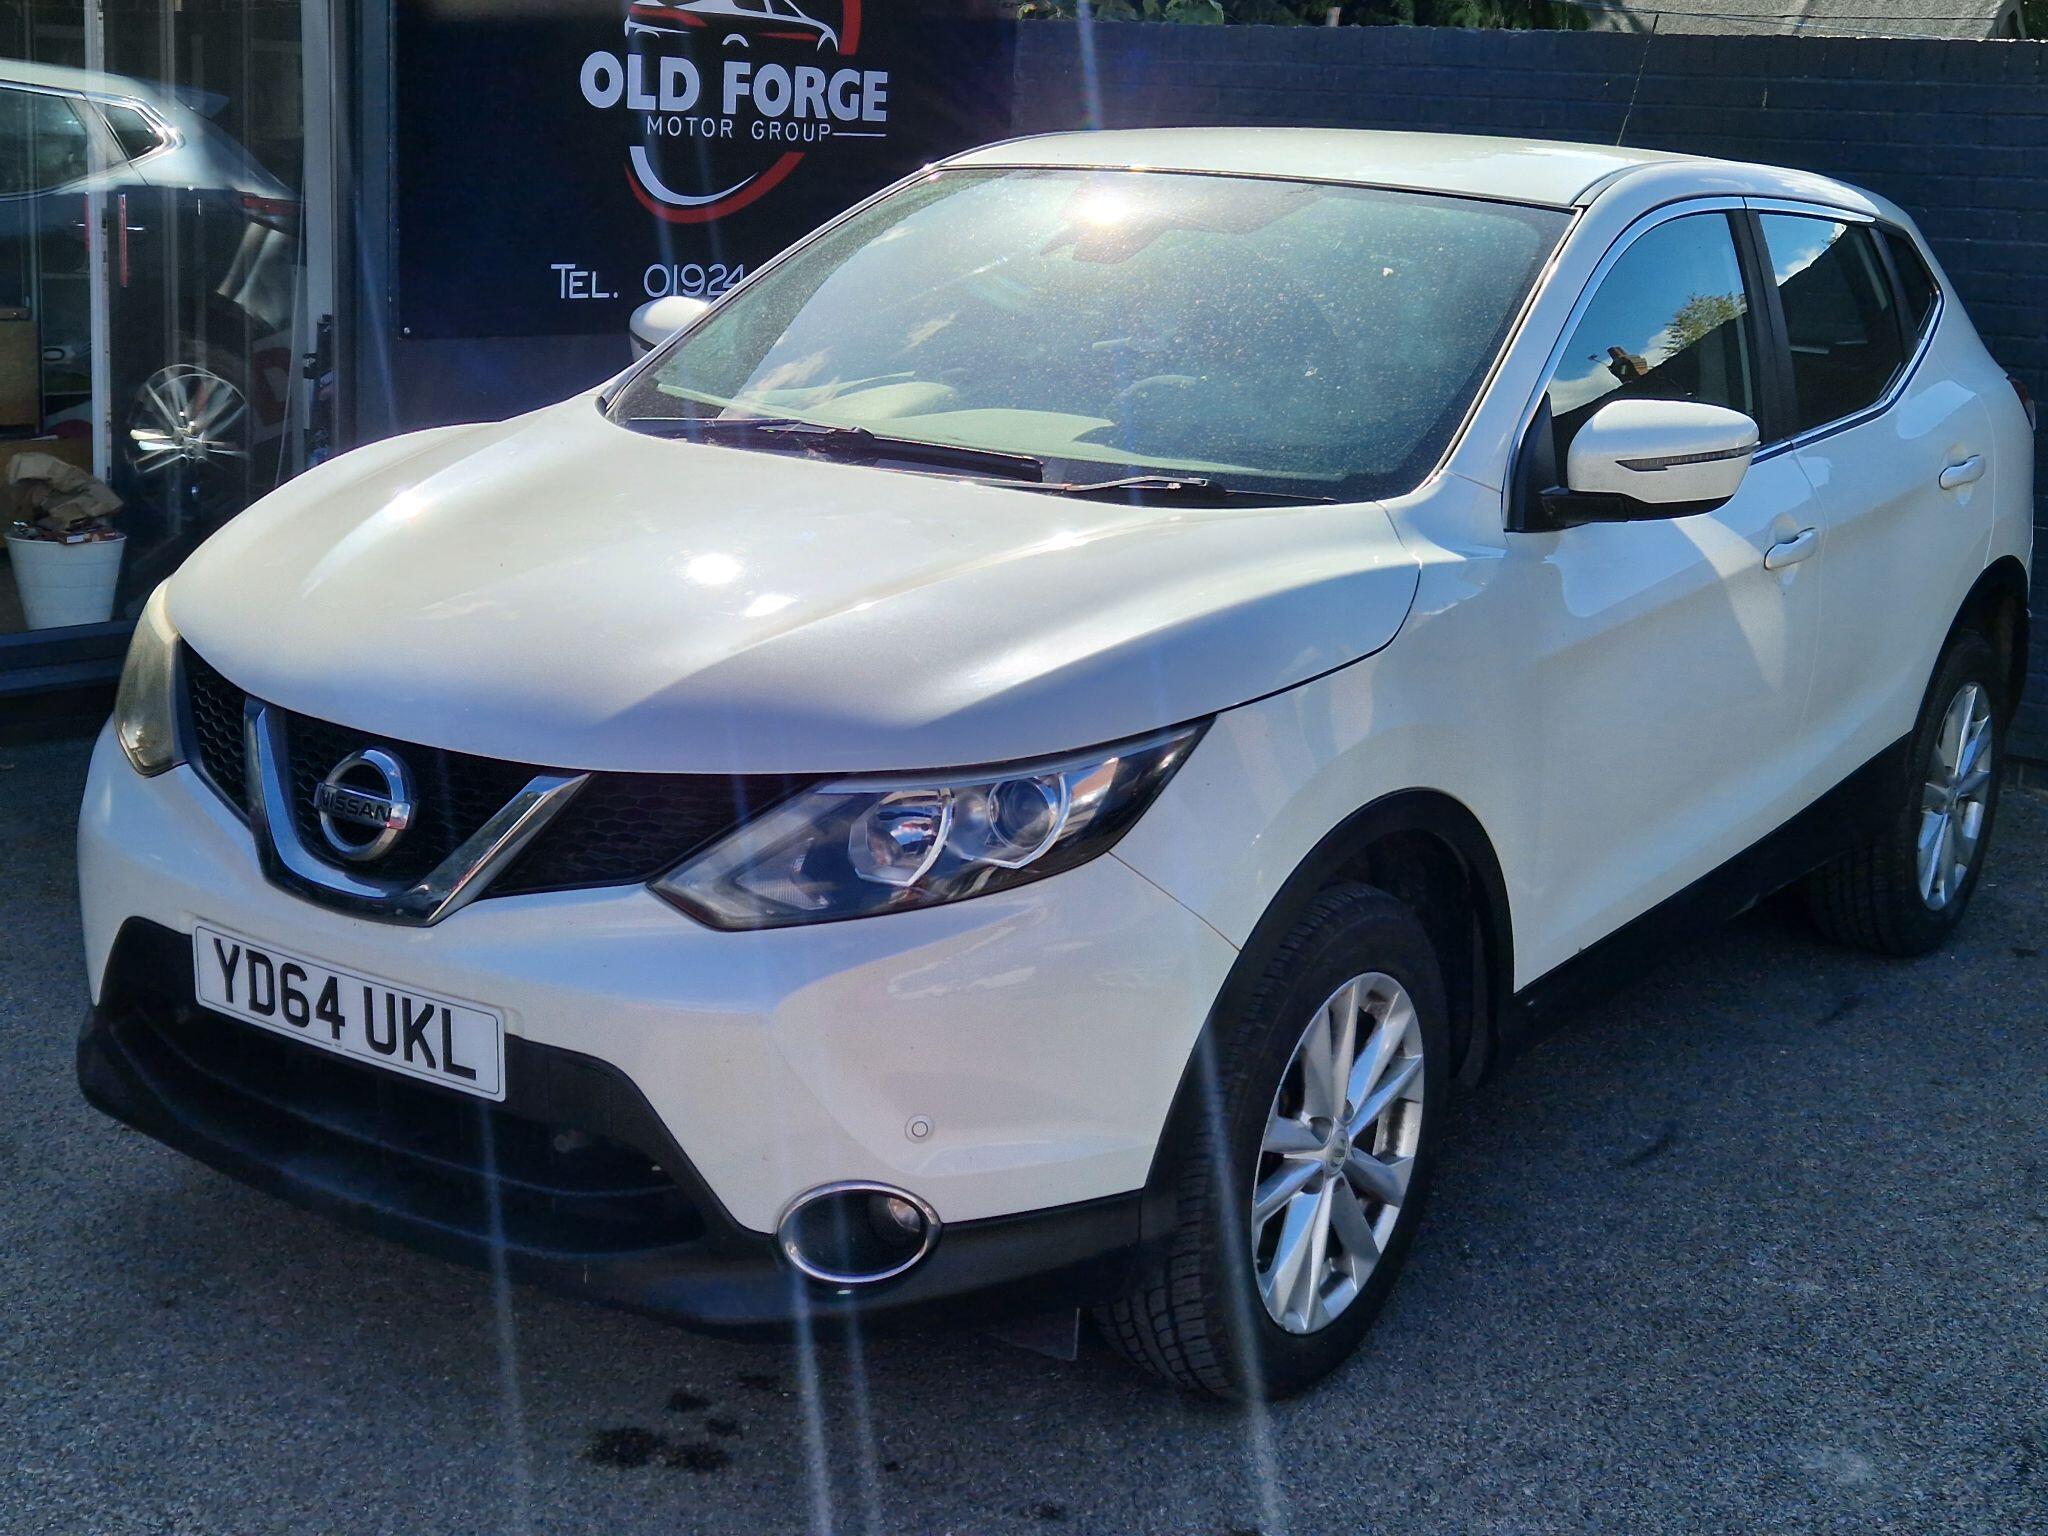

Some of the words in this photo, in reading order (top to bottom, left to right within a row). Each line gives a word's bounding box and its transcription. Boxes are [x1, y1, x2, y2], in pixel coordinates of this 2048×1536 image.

[580, 50, 700, 112] OLD
[722, 60, 889, 122] FORGE
[646, 115, 734, 139] MOTOR
[751, 120, 831, 142] GROUP
[319, 788, 393, 823] NISSAN
[213, 938, 346, 1041] YD64
[363, 986, 477, 1080] UKL
